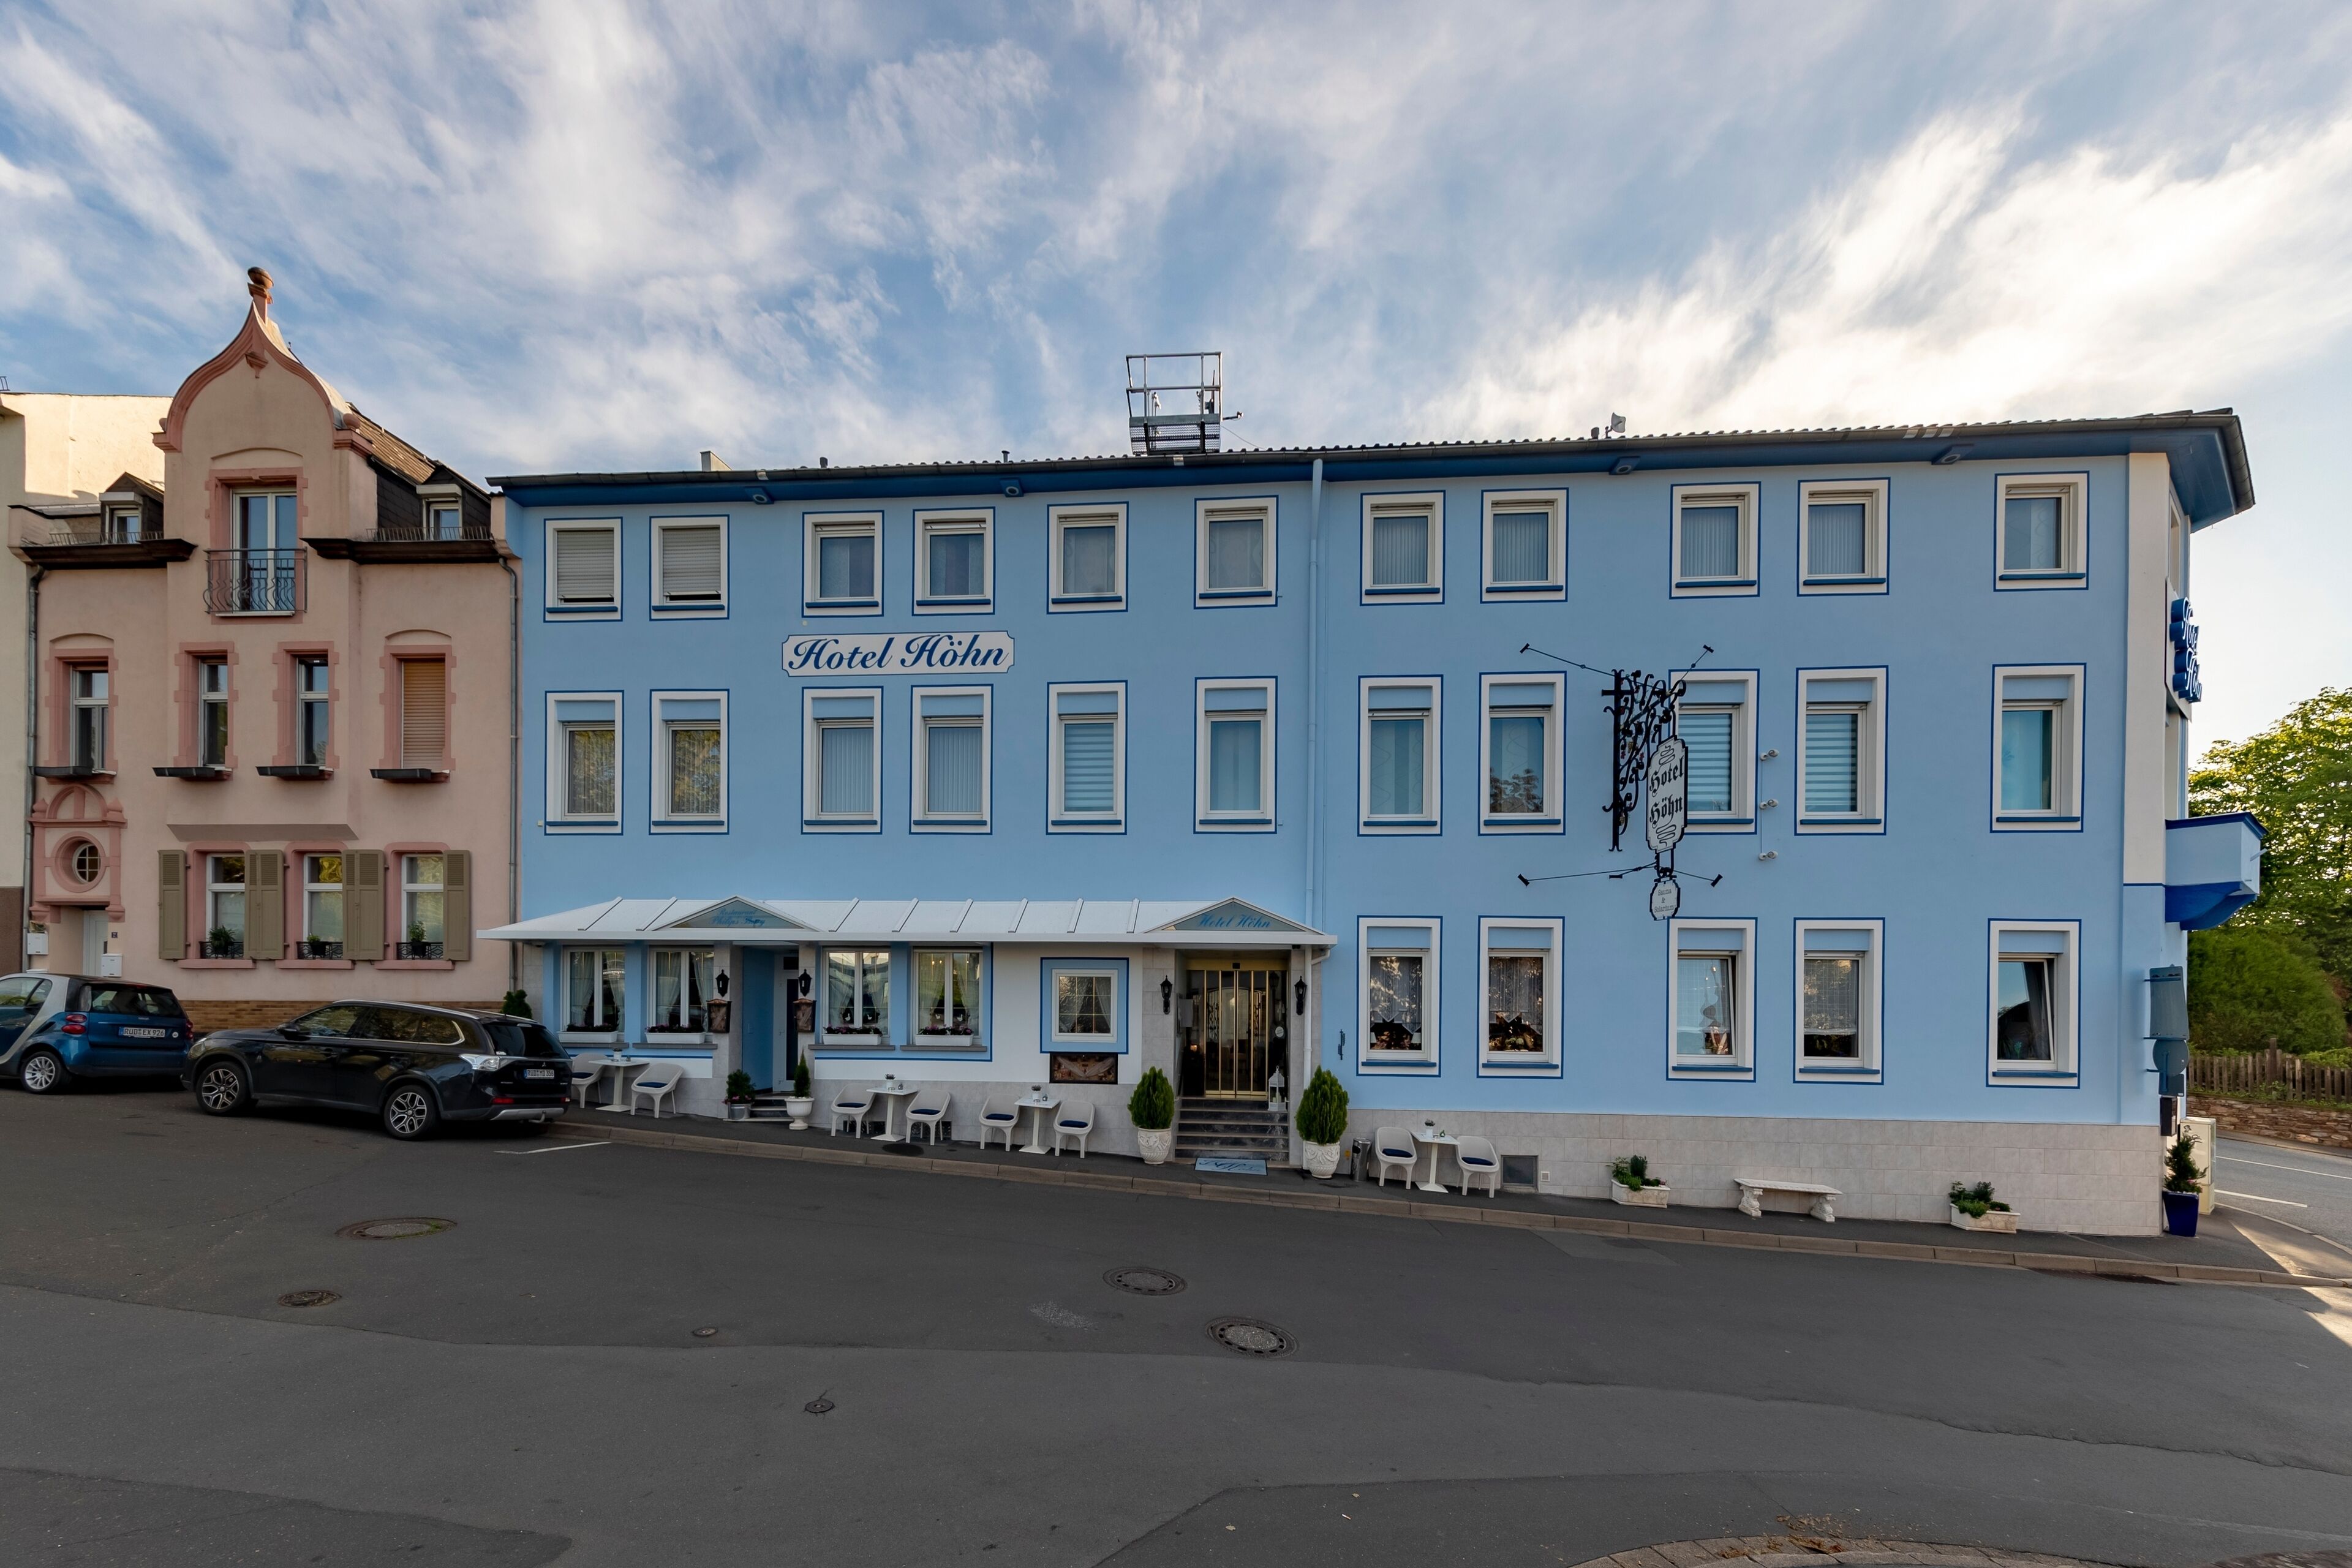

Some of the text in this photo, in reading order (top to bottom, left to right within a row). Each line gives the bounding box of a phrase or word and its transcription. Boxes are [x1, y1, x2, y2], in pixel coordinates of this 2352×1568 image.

[788, 634, 1009, 669] Hotel Höhn
[1649, 755, 1684, 797] Hotel
[1649, 794, 1683, 829] Höhn
[1199, 914, 1270, 928] Hotel Höhn
